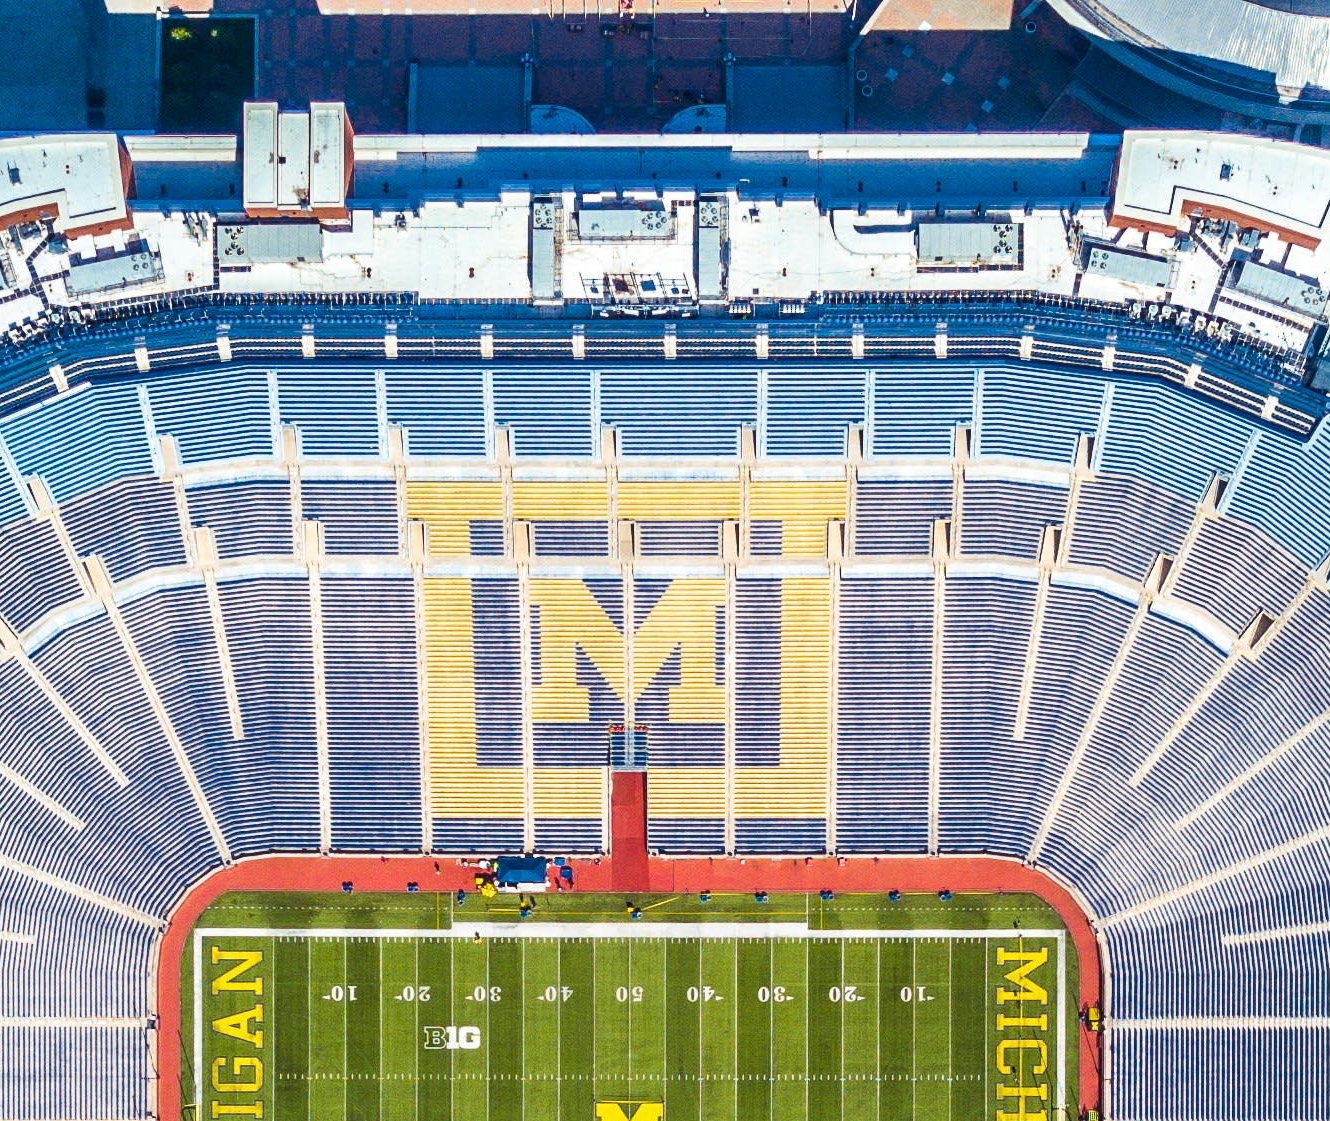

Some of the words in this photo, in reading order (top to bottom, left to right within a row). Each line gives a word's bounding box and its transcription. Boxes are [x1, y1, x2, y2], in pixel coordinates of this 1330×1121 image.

[530, 578, 725, 723] M
[331, 985, 357, 1002] 10
[403, 985, 431, 1002] 20
[474, 985, 501, 1002] 30
[545, 985, 573, 1002] 40
[616, 985, 643, 1002] 50
[687, 985, 714, 1002] 40
[758, 985, 785, 1002] 30
[829, 985, 857, 1002] 20
[901, 985, 926, 1002] 10
